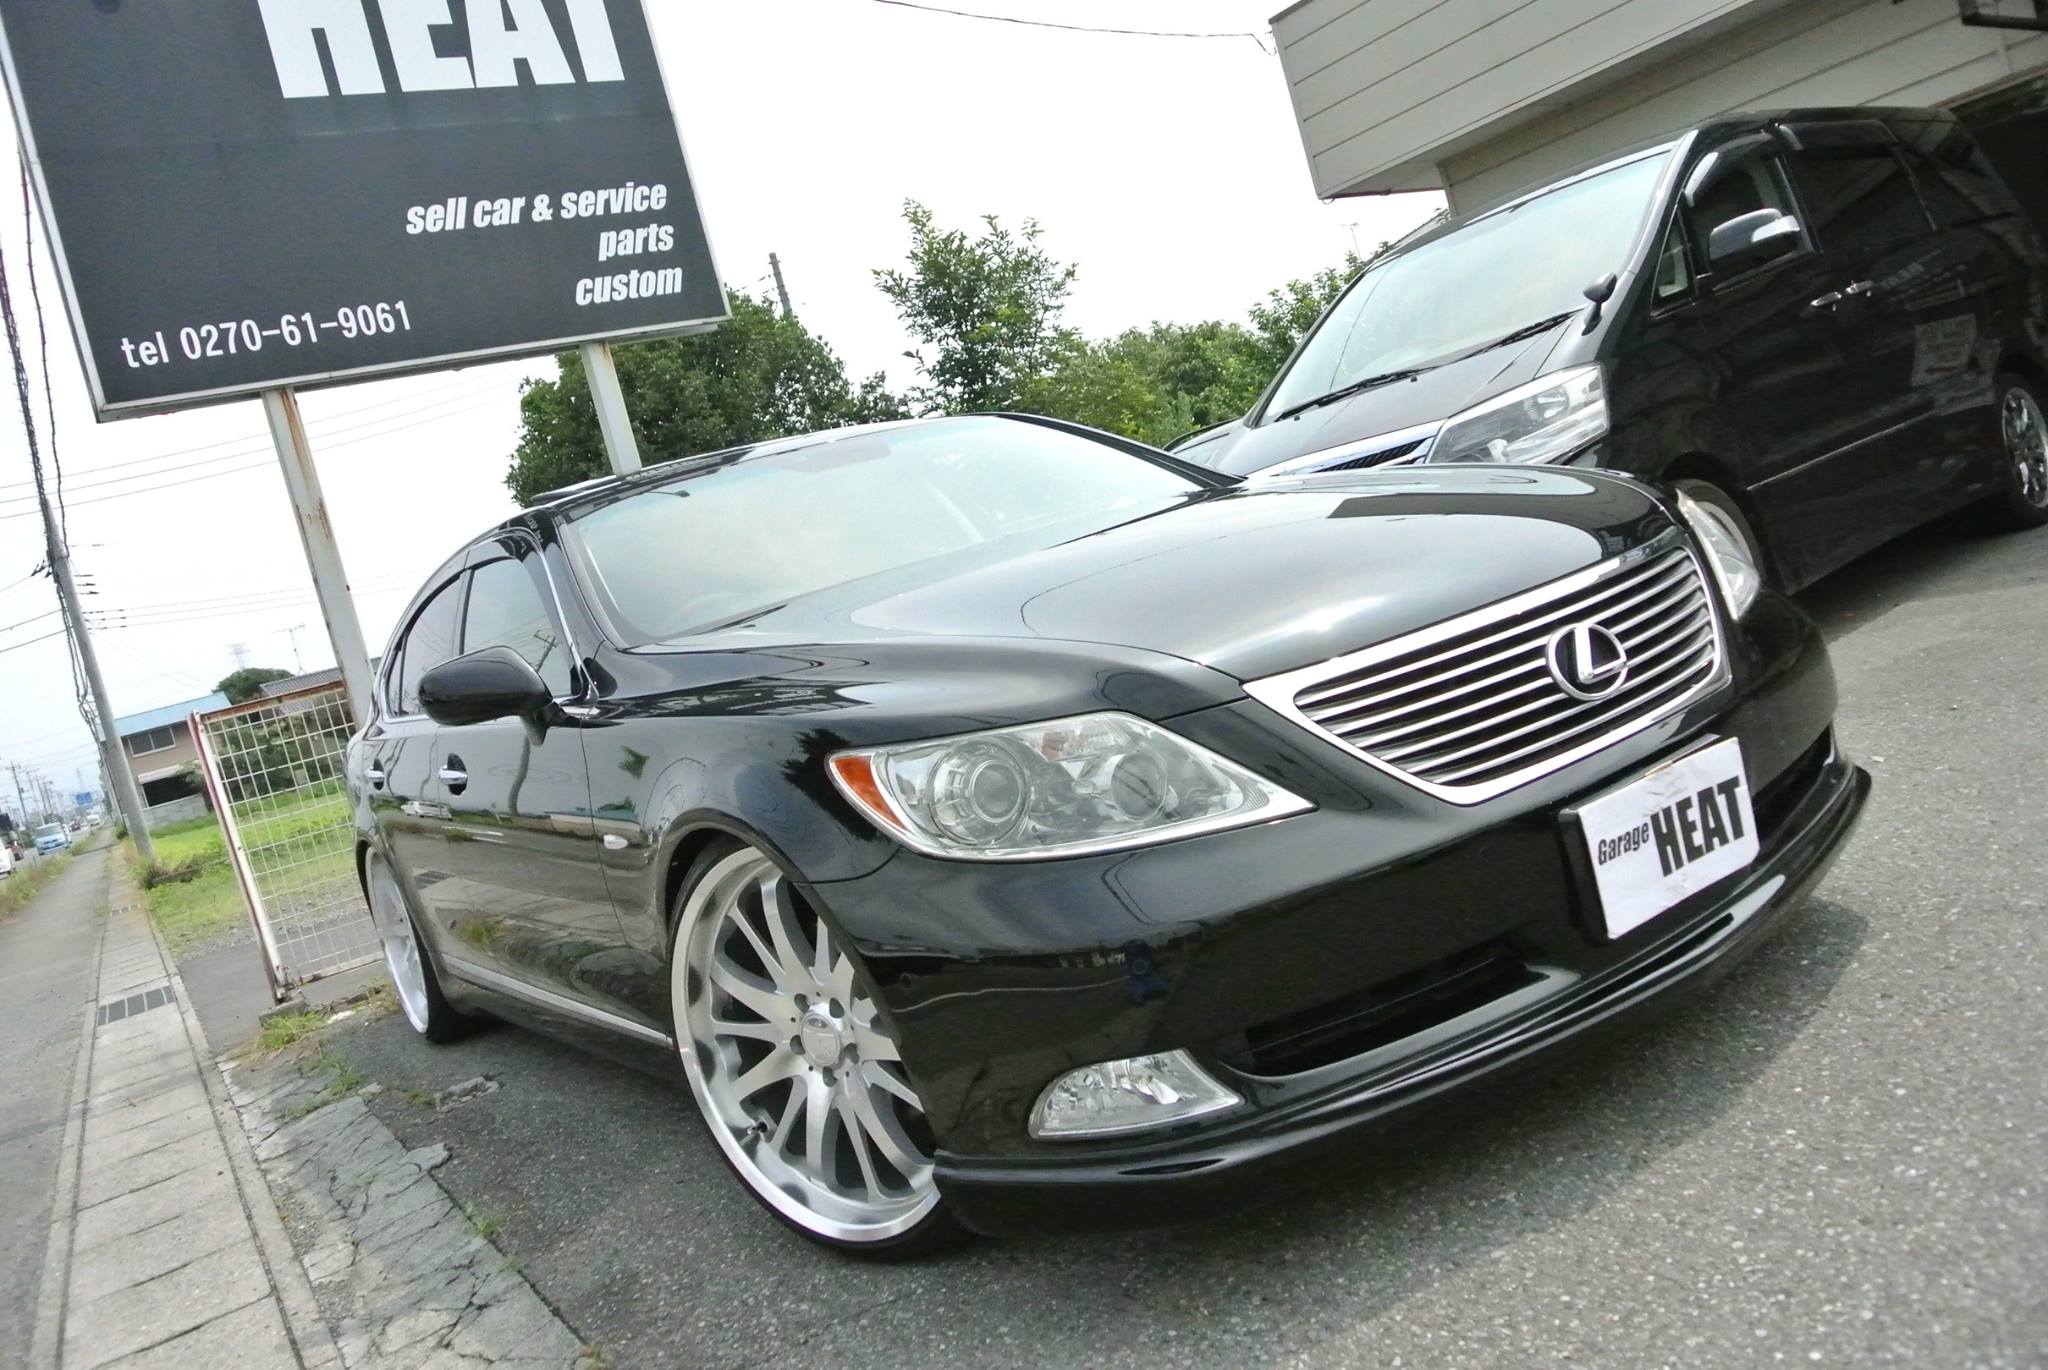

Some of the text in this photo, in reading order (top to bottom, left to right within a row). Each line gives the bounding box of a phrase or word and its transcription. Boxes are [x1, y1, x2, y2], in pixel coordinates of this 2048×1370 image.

[406, 182, 668, 235] sell car & service
[598, 223, 675, 262] parts
[575, 266, 683, 306] custom
[120, 301, 412, 368] tel 0270-61-9061
[1597, 775, 1744, 877] Garage HEAT
